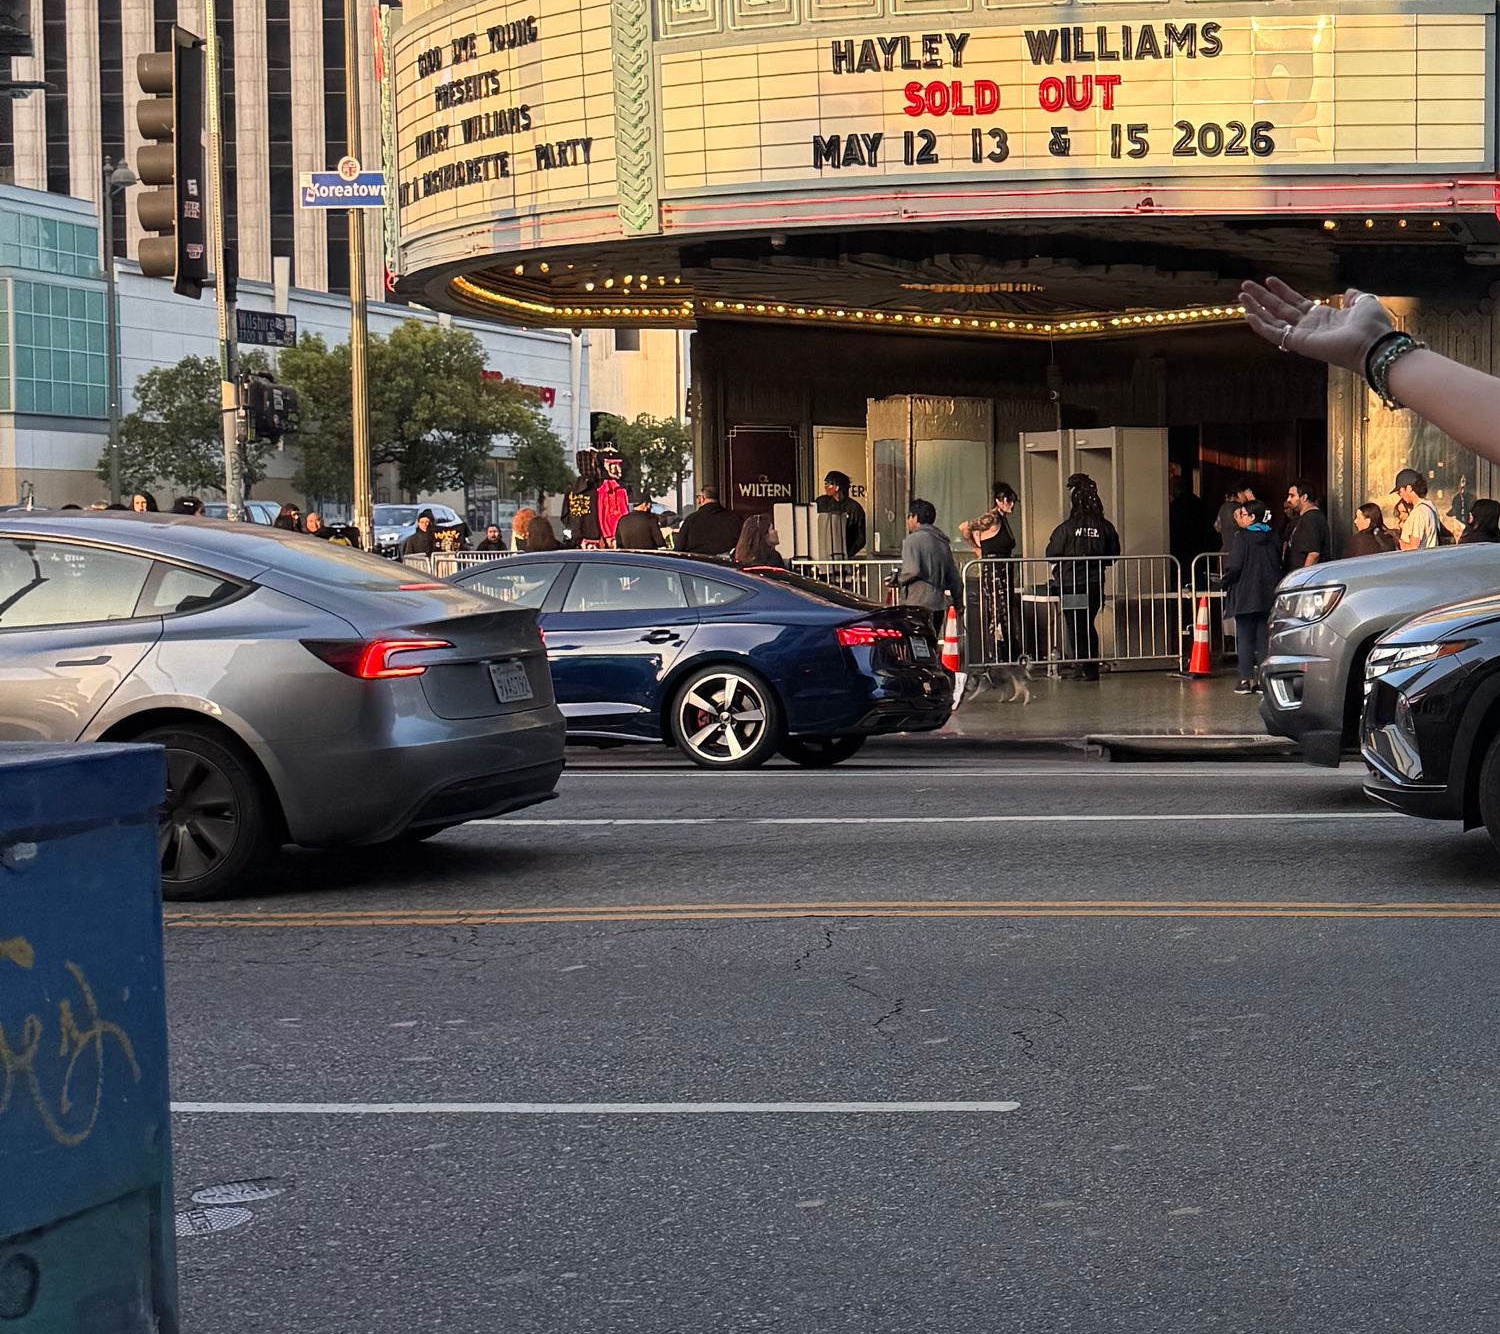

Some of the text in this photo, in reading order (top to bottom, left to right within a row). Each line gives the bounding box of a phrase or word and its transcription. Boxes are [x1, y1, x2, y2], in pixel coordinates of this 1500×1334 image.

[486, 15, 538, 54] YOUNG
[832, 21, 1223, 74] HAYLEY WILLIAMS
[434, 69, 500, 112] PRESENTS
[903, 74, 1122, 117] SOLD OUT
[460, 104, 532, 145] WILLIAMS
[813, 120, 1276, 169] MAY 12 13 & 15 2026
[535, 137, 593, 172] PARTY
[238, 311, 275, 332] Wilshire
[738, 483, 792, 498] WILTERN
